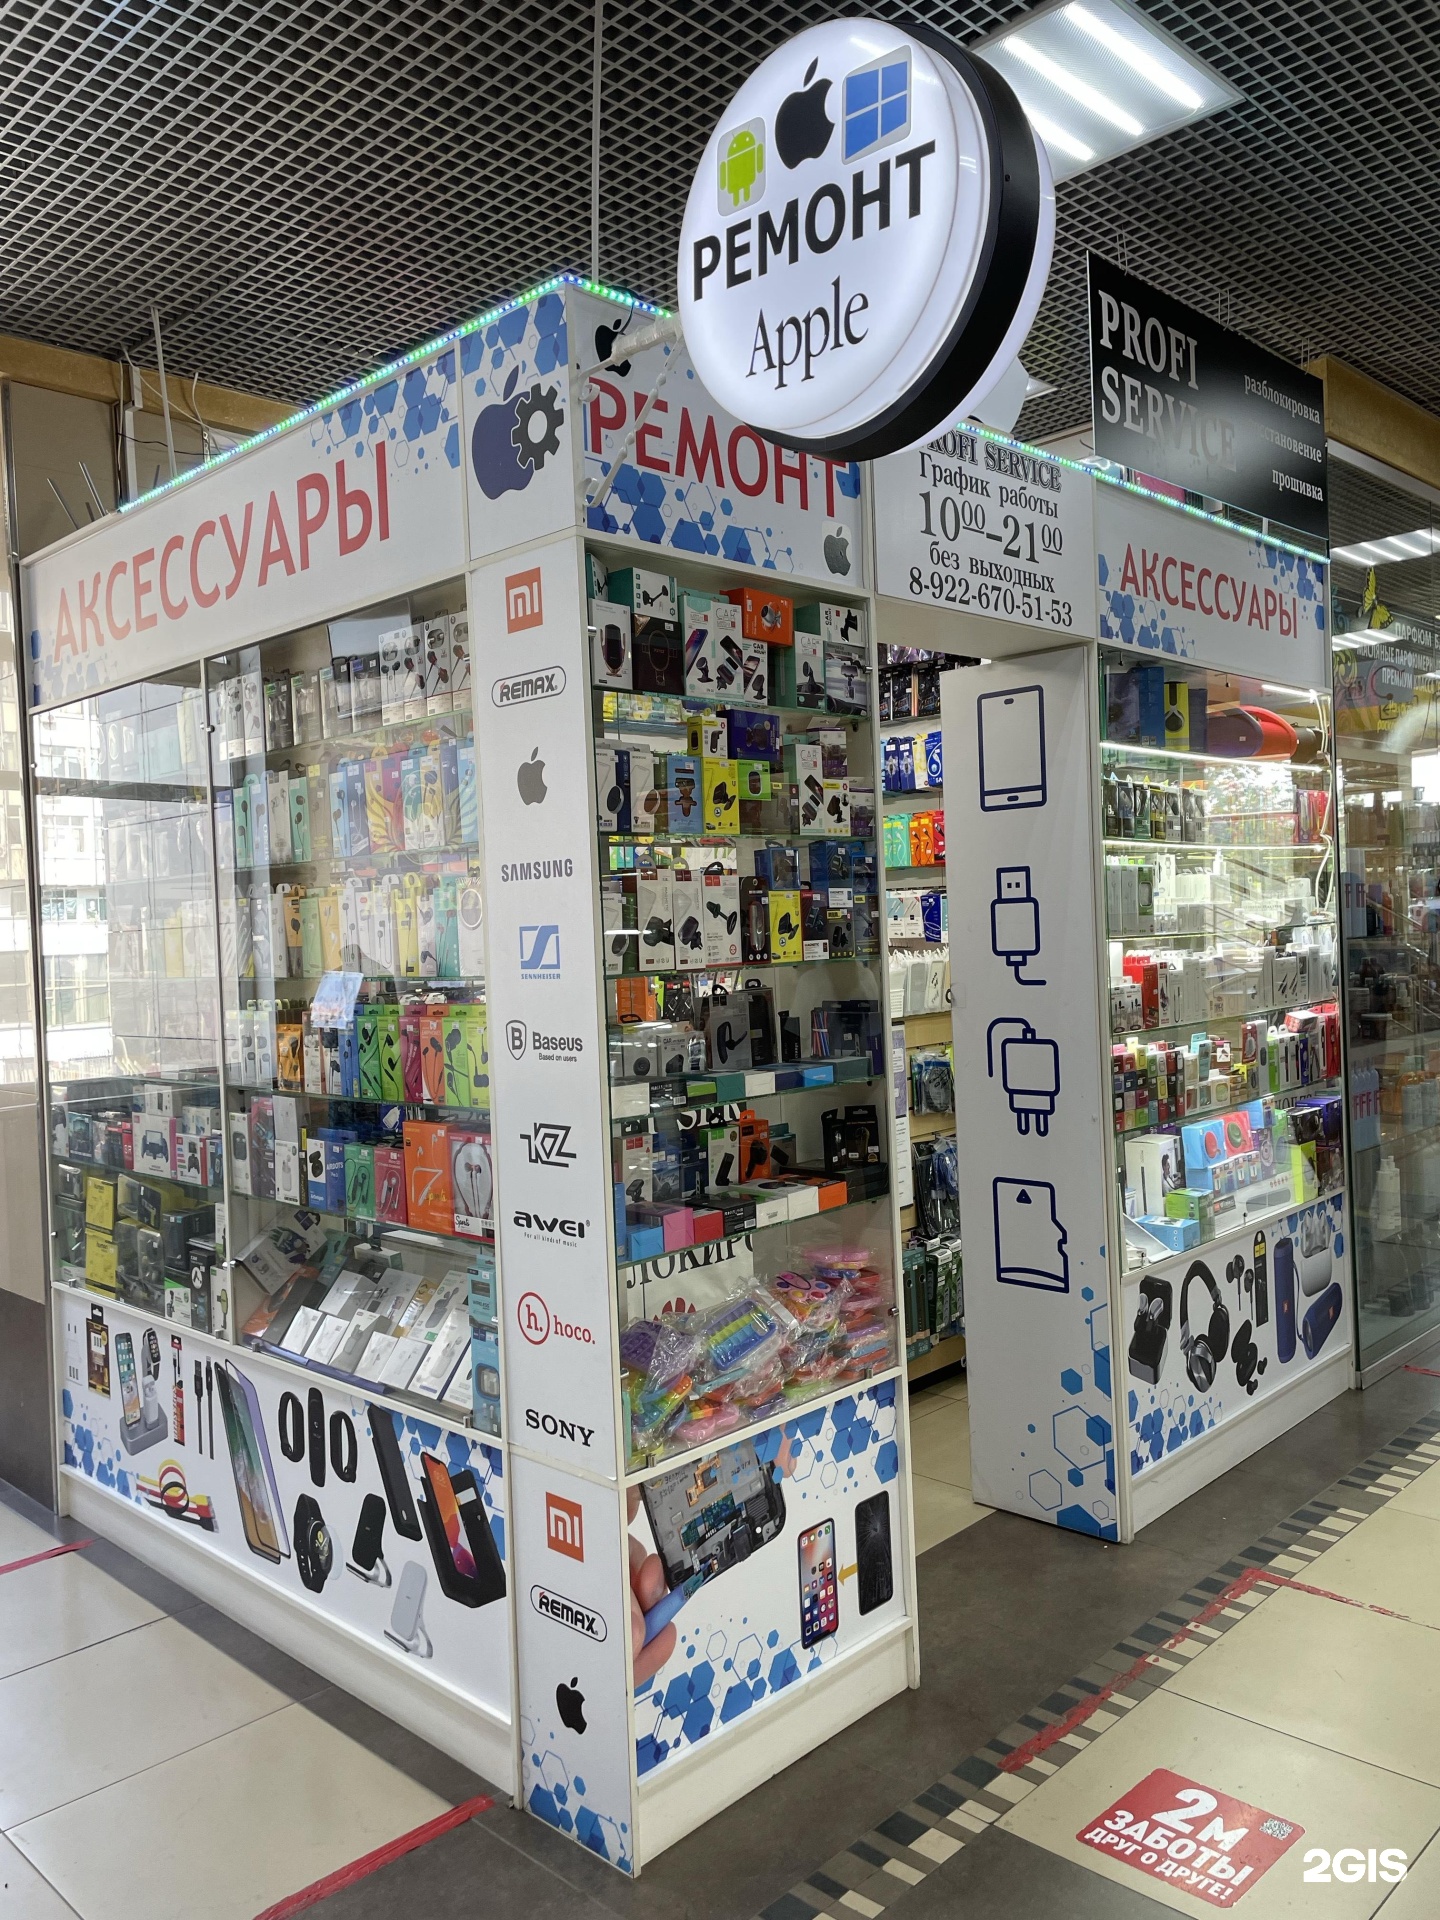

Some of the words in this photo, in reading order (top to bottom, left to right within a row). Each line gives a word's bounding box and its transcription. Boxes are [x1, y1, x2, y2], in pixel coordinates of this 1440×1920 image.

[693, 139, 936, 302] РЕМОНТ
[746, 275, 869, 390] Apple
[1098, 289, 1199, 391] PROFI
[1101, 365, 1237, 472] SERVICE
[1244, 374, 1321, 424] разблокировка
[589, 377, 846, 518] РЕМОНТ
[984, 441, 1062, 493] SERVICE
[919, 450, 991, 498] График
[999, 484, 1059, 519] работы
[1272, 469, 1324, 502] прошивка
[53, 441, 390, 664] АКСЕССУАРЫ
[929, 541, 960, 570] без
[969, 556, 1056, 593] выходных
[909, 566, 1073, 627] 8-922-670-51-53
[1120, 542, 1298, 640] АКСЕССУАРЫ
[501, 858, 573, 882] SAMSUNG
[533, 1031, 583, 1052] Baseus
[539, 1053, 554, 1061] Based
[525, 1408, 595, 1448] SONY
[1085, 1827, 1142, 1856] ДРУГ
[1140, 1851, 1157, 1865] О
[1155, 1858, 1234, 1900] ДРУГЕ!
[1104, 1810, 1254, 1887] ЗАБОТЫ
